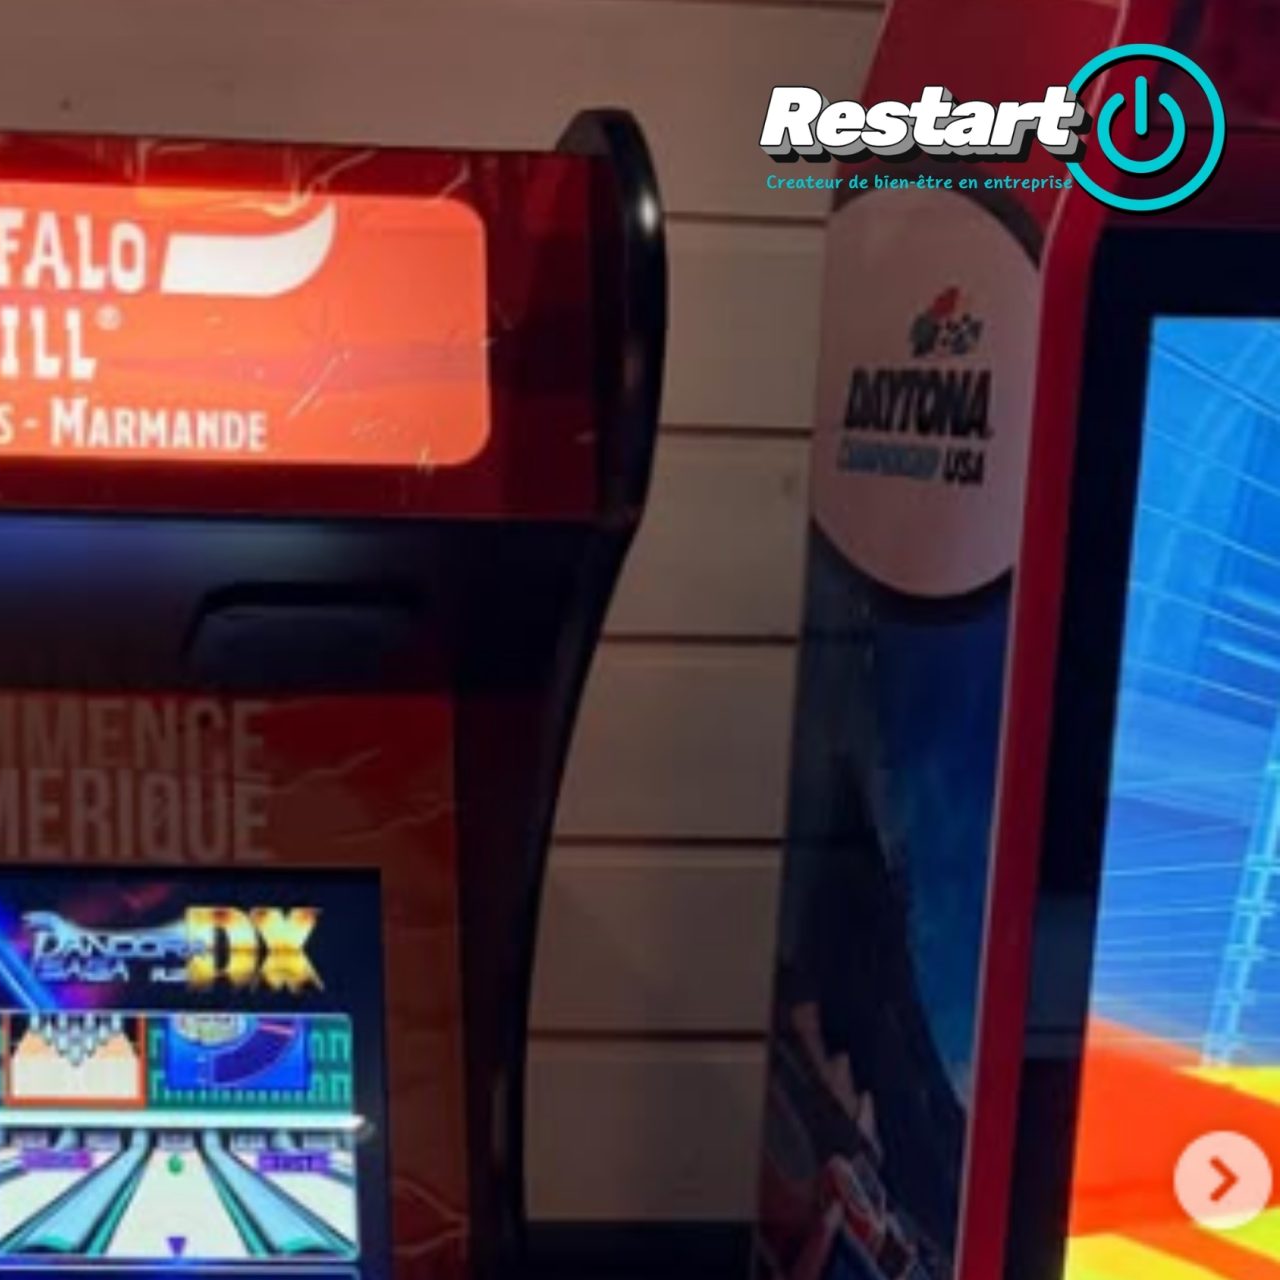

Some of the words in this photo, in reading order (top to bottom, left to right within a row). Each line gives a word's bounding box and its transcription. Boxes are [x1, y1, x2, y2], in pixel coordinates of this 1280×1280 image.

[49, 396, 267, 453] MARMANDE
[843, 366, 992, 440] DAYTONA
[942, 449, 985, 486] USA
[184, 905, 325, 991] DX
